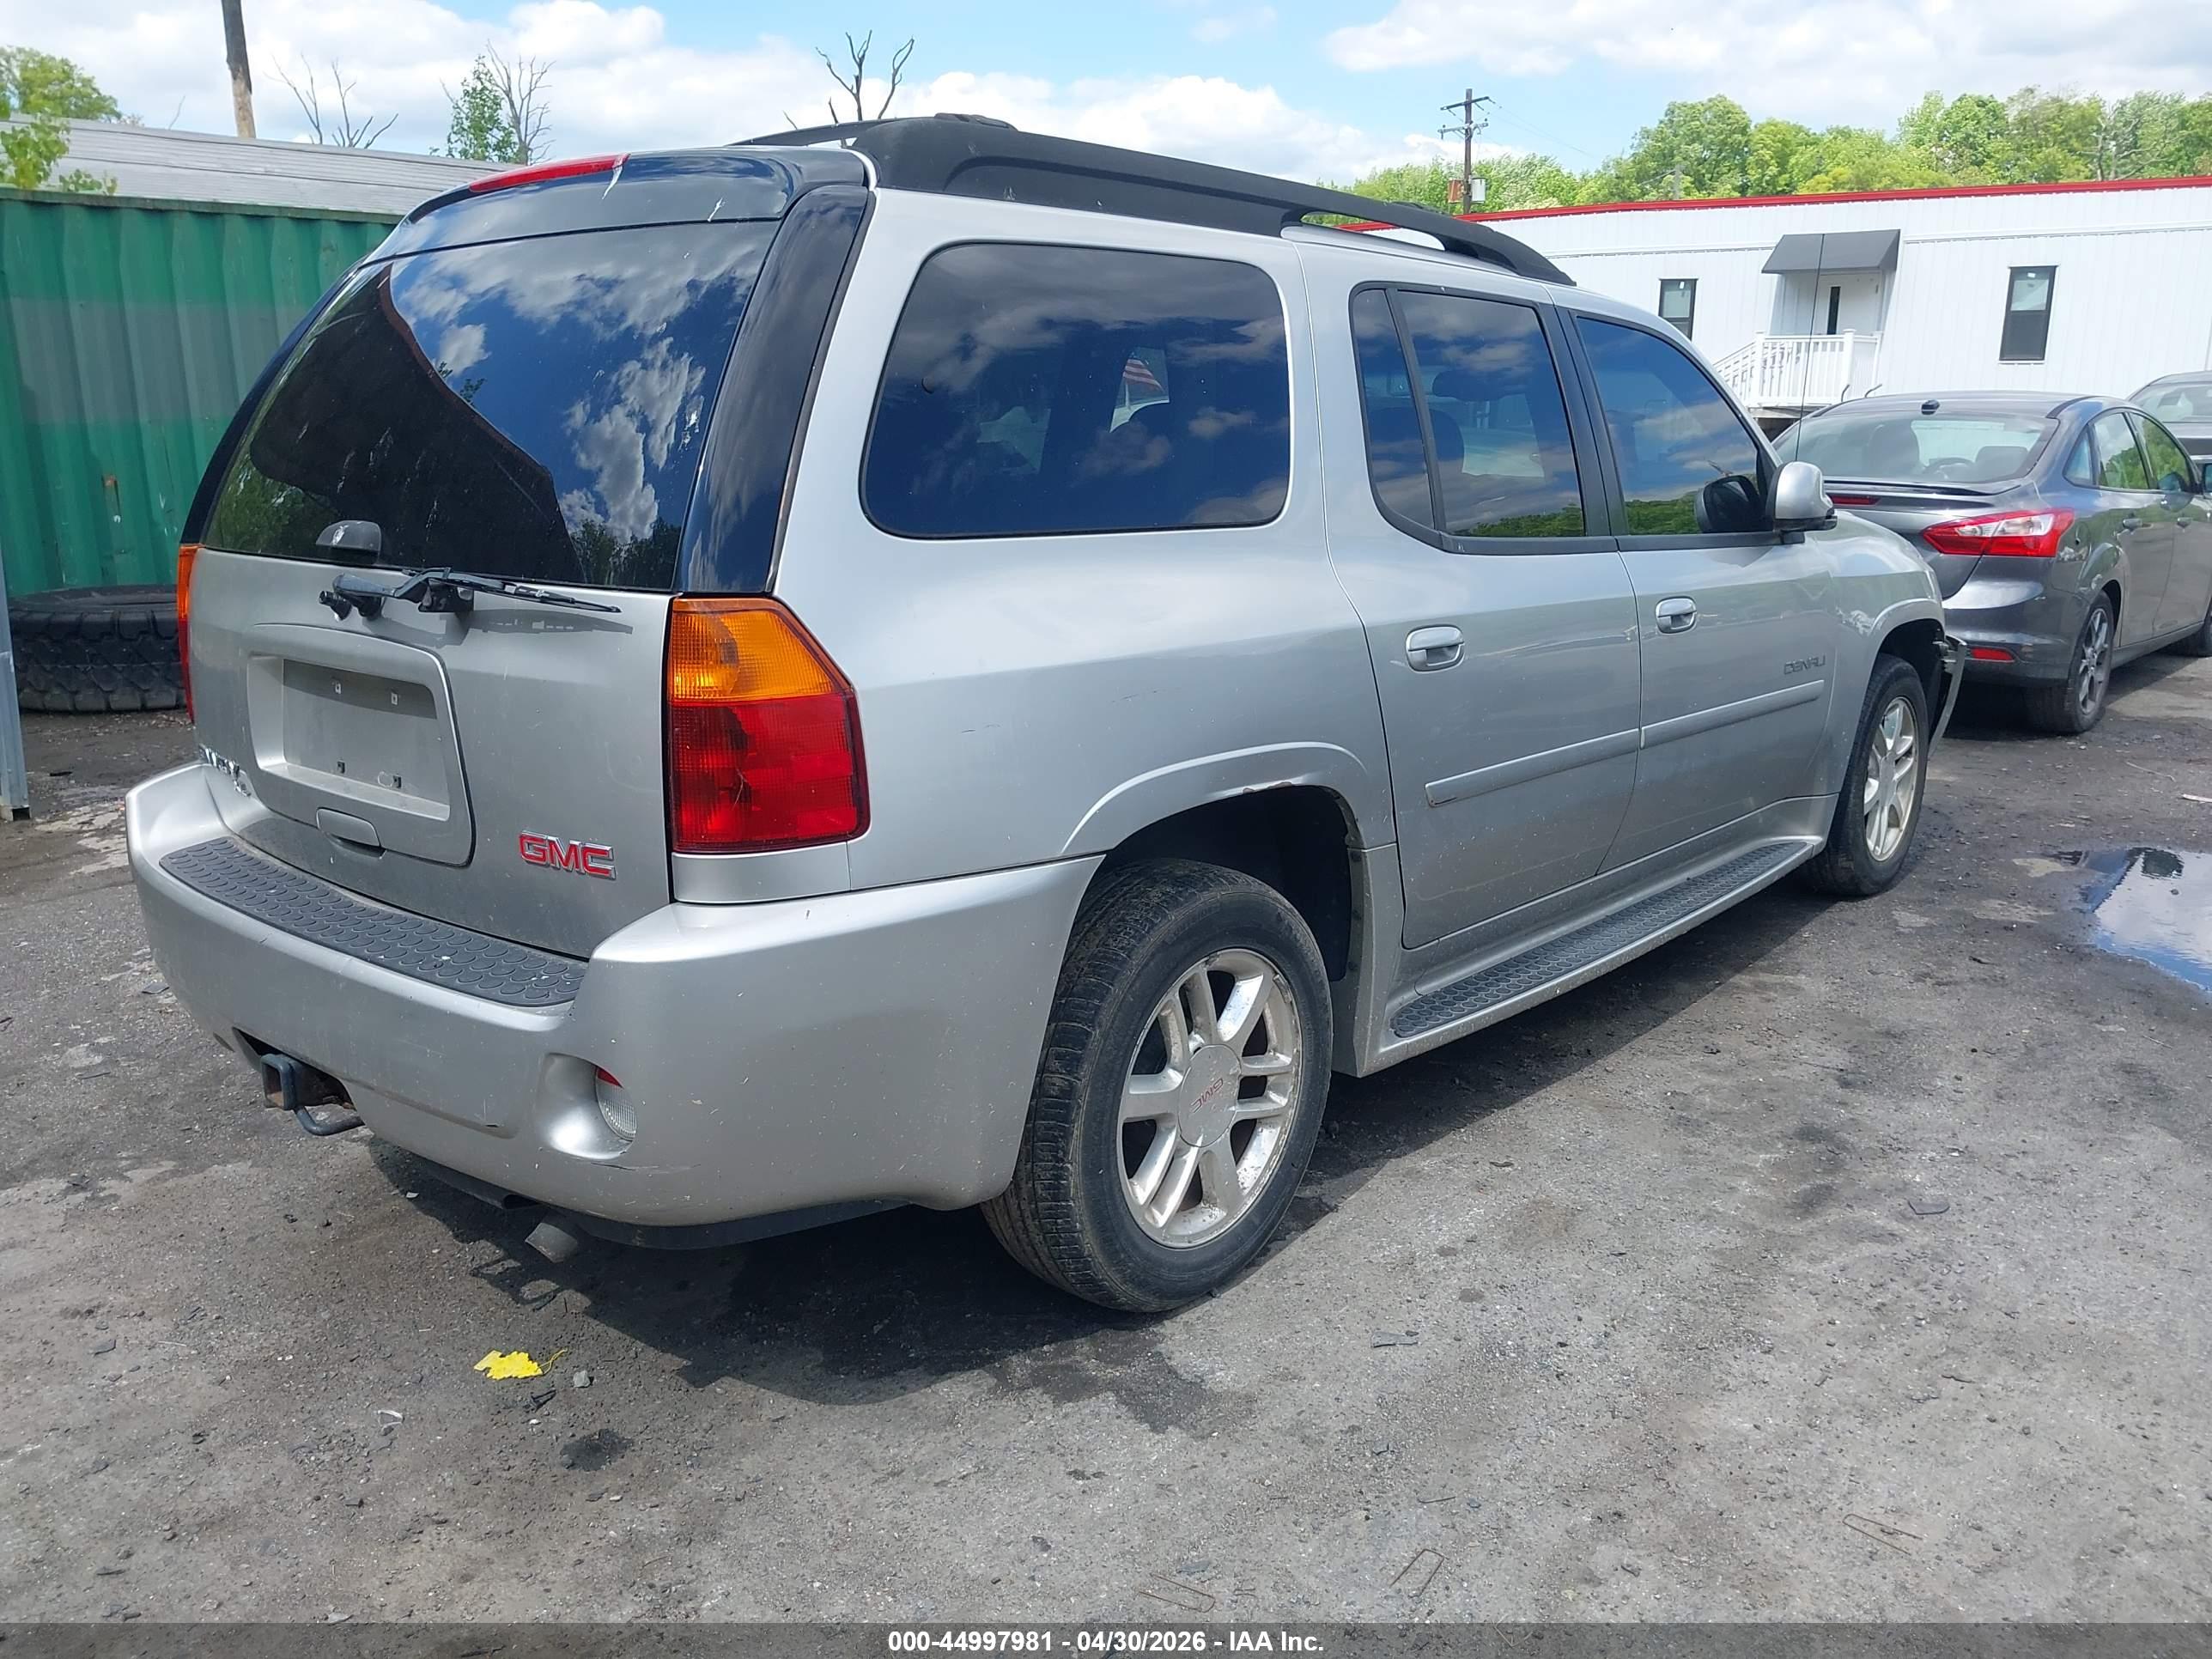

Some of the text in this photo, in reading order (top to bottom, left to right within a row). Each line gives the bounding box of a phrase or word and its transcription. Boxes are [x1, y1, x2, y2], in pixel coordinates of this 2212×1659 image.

[1784, 654, 1826, 675] DENALI
[519, 830, 617, 881] GMC
[1190, 1078, 1224, 1114] GMC
